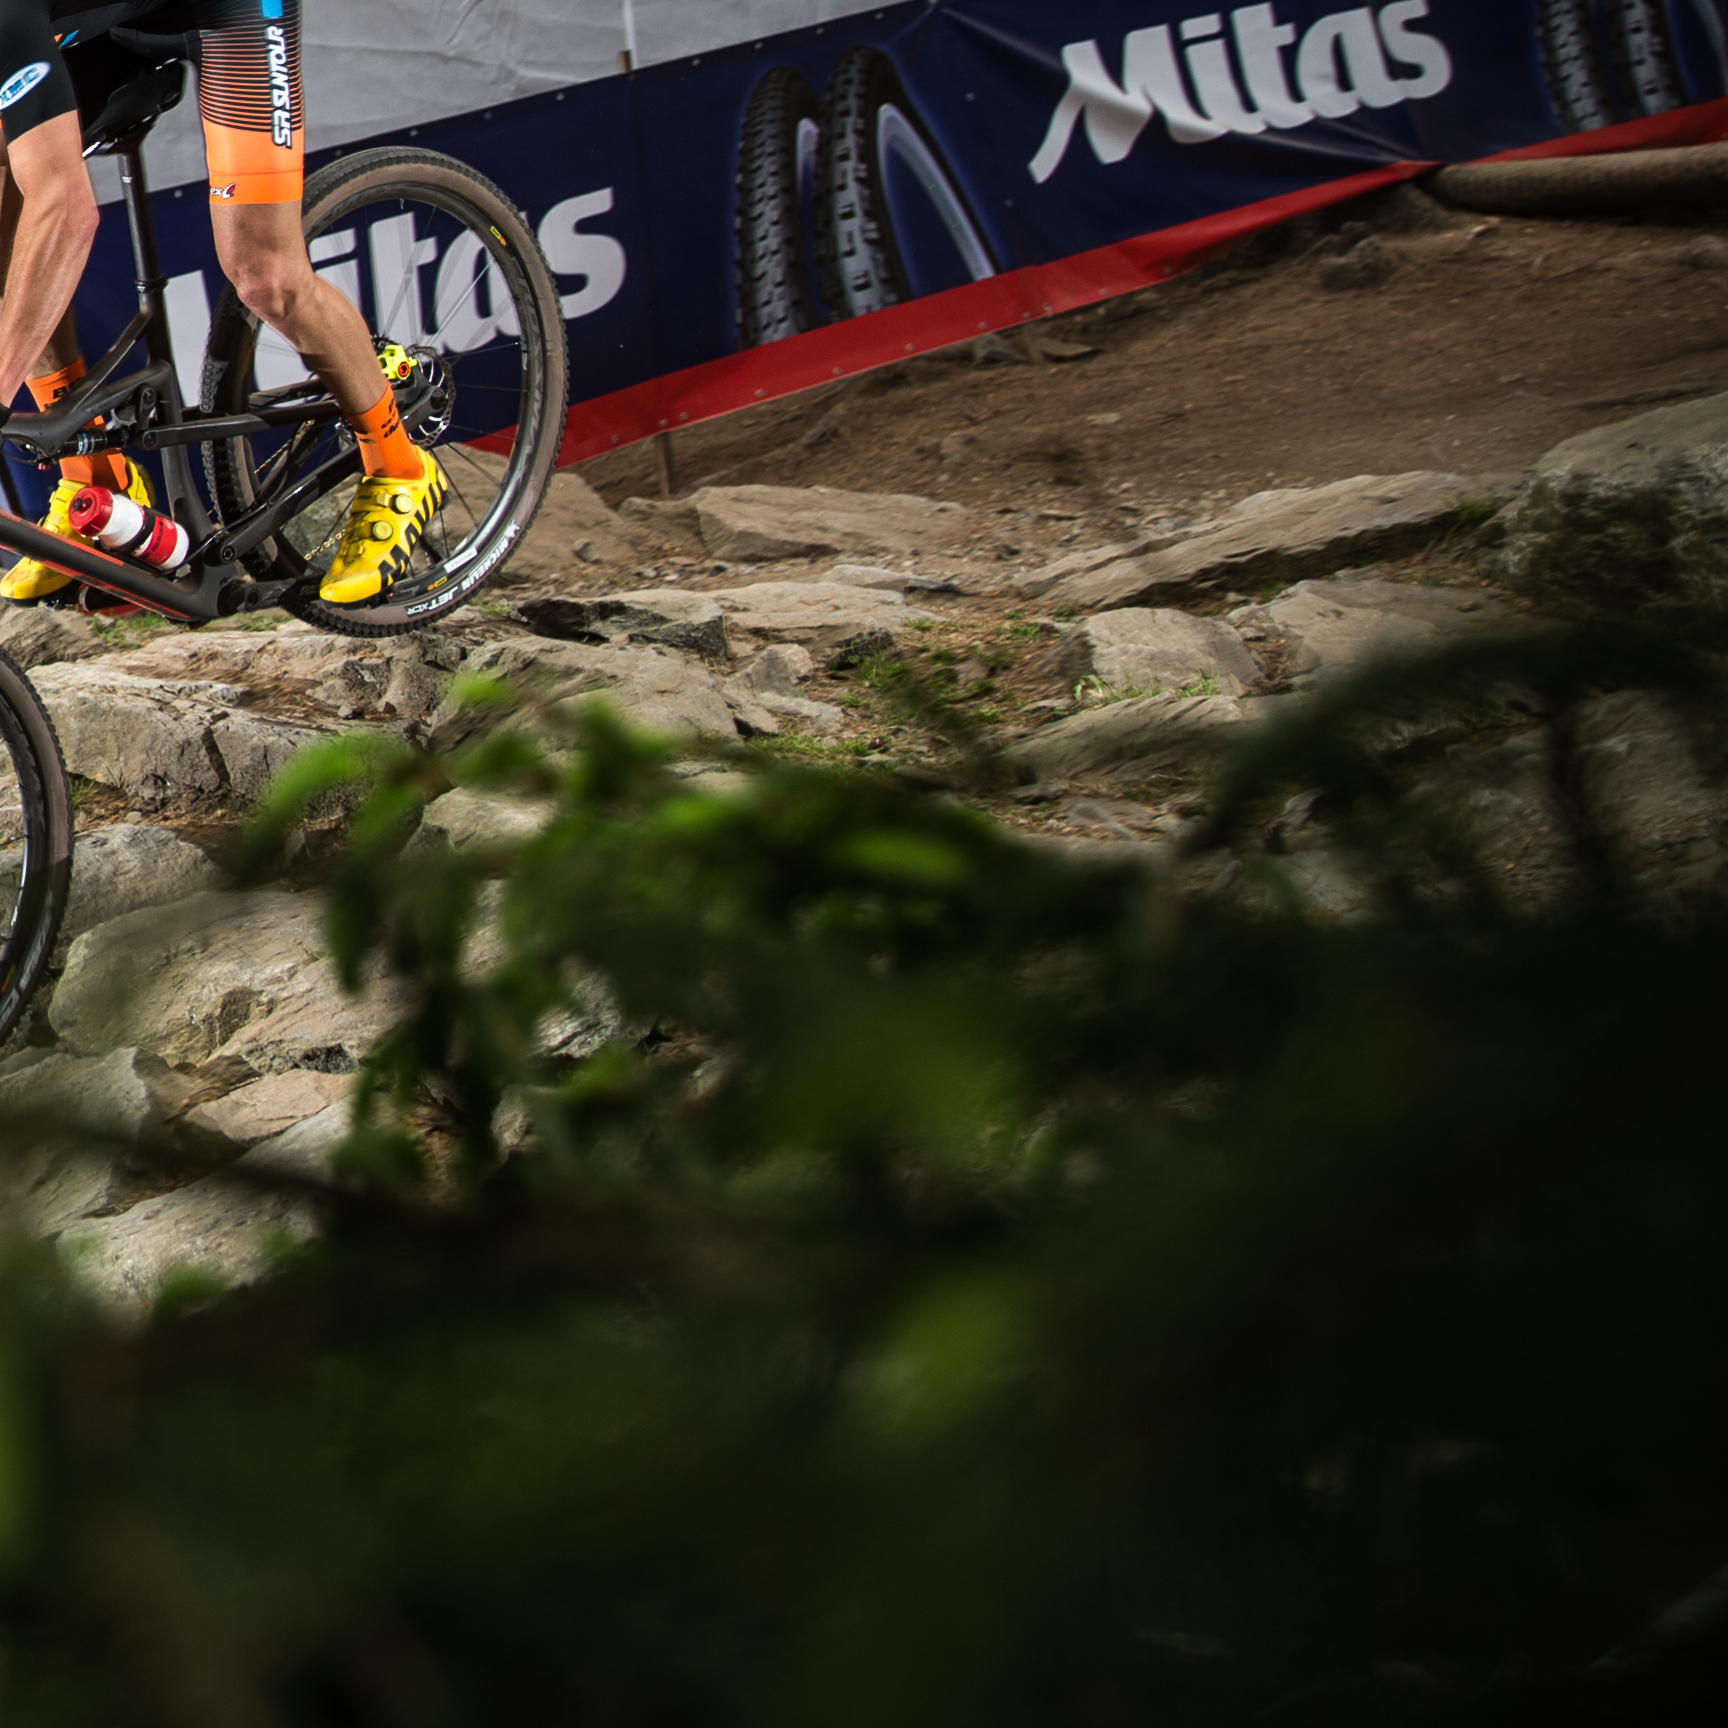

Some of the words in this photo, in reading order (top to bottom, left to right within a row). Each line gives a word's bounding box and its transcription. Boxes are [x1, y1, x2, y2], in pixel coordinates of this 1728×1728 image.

[265, 25, 290, 109] SUNTOUR
[460, 535, 510, 593] MICHELIN
[428, 585, 459, 611] JET
